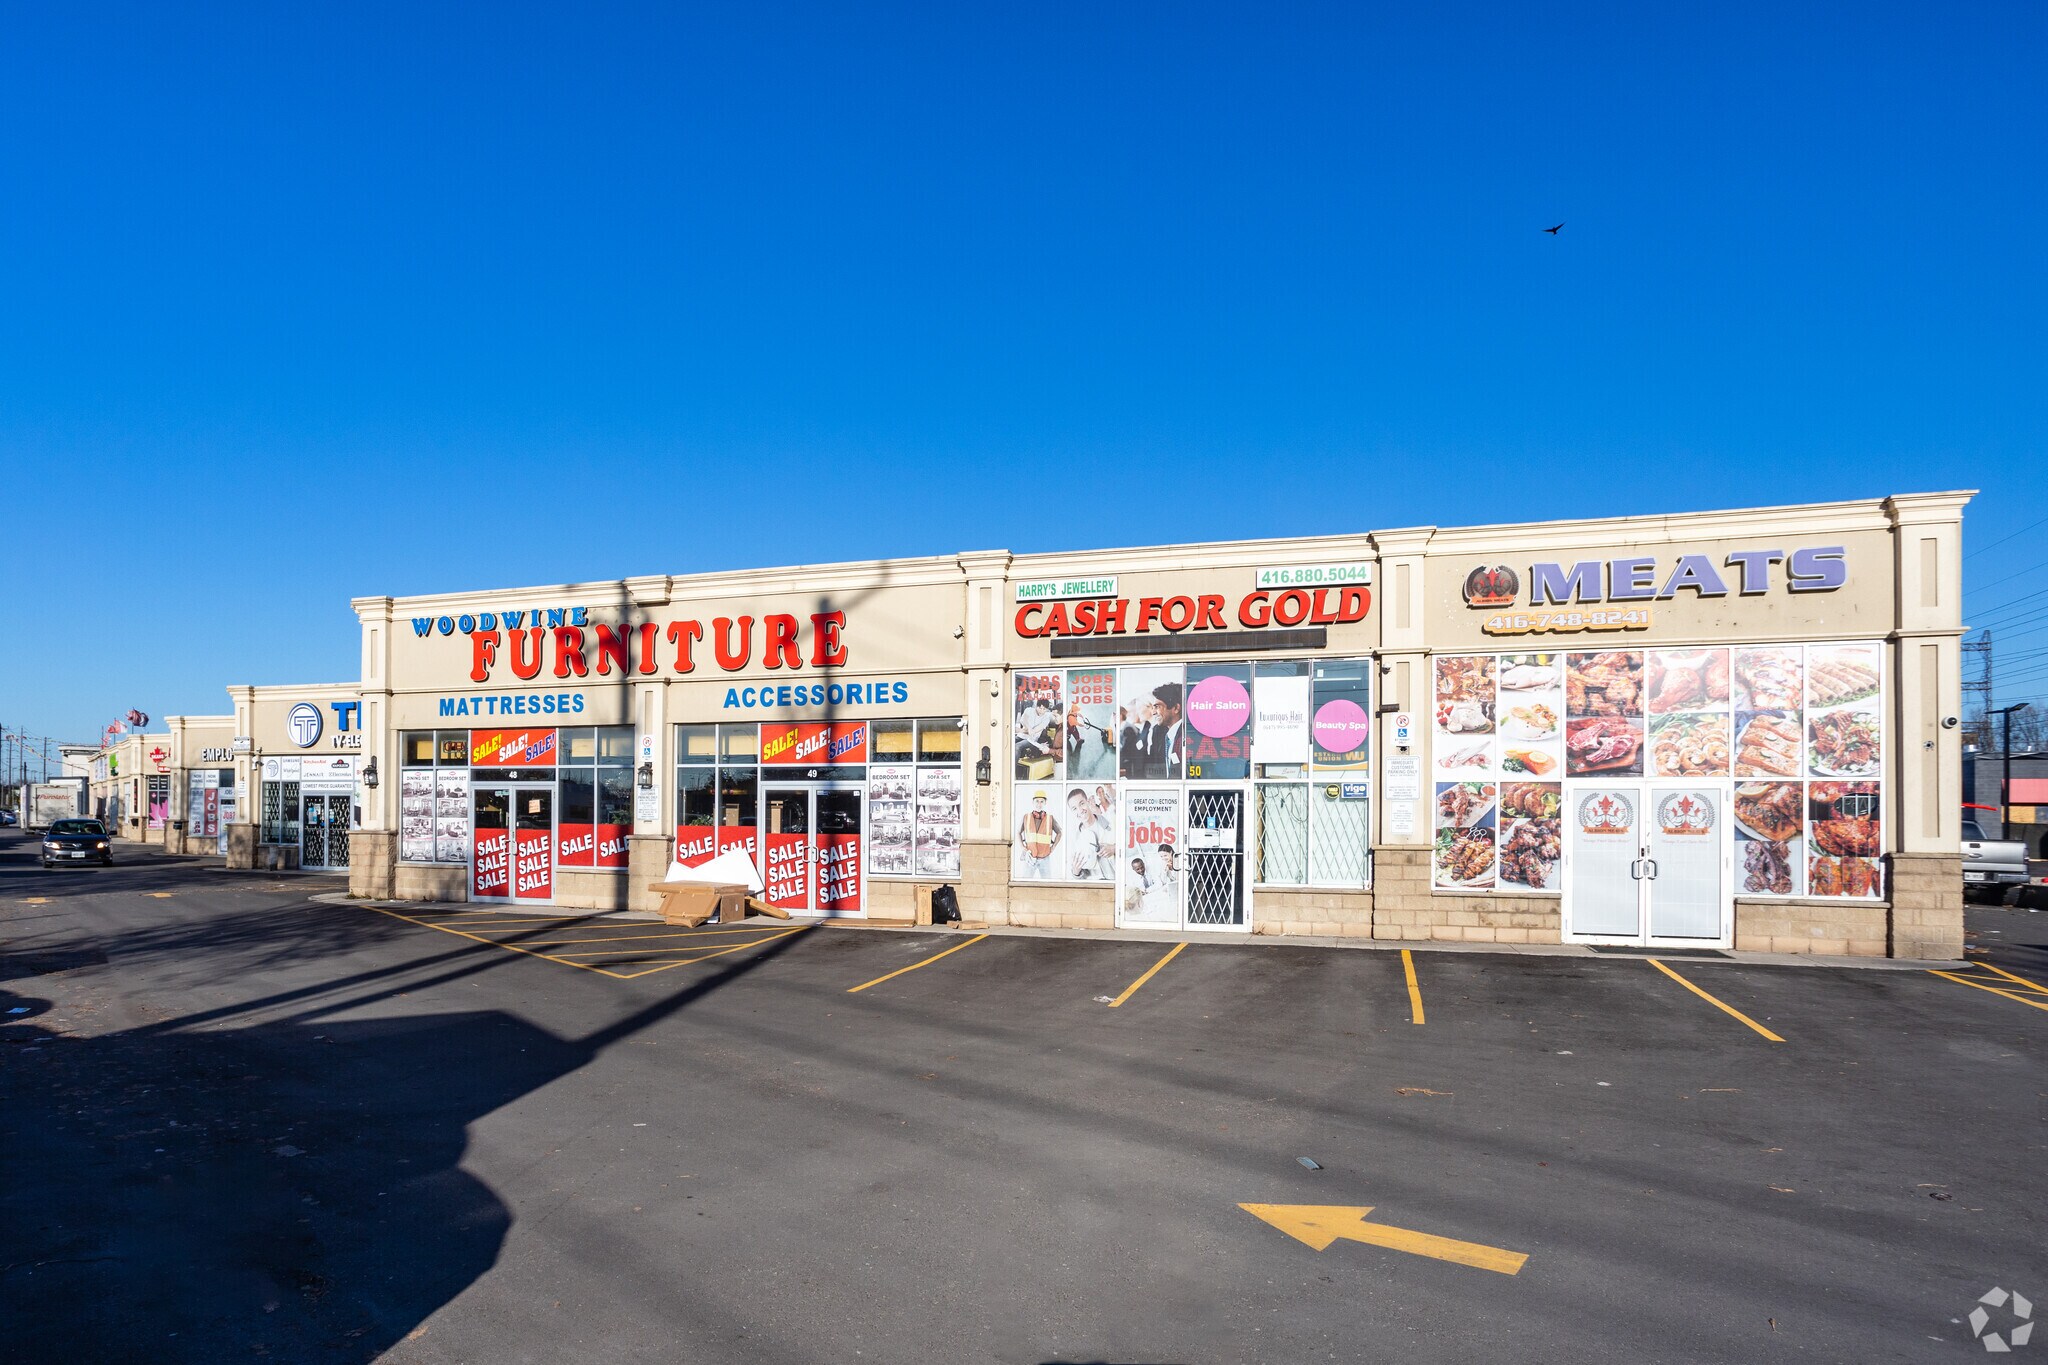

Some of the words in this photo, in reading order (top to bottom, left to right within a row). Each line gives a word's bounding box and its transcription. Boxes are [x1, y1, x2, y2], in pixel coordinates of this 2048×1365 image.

[1261, 566, 1367, 584] 416.880.5044
[1531, 546, 1847, 603] MEATS
[1018, 583, 1057, 598] HARRY'S
[1061, 579, 1115, 596] JEWELLERY
[411, 606, 588, 637] WOODWINE
[1014, 598, 1130, 639] CASH
[1134, 594, 1228, 633] FOR
[1238, 587, 1372, 628] GOLD
[1487, 610, 1650, 630] 416-748-8241
[470, 610, 848, 682] FURNITURE
[1018, 675, 1061, 692] JOBS
[1071, 674, 1113, 685] JOBS
[1071, 685, 1113, 695] JOBS
[439, 693, 585, 717] MATTRESSES
[723, 681, 909, 709] ACCESSORIES
[1071, 695, 1113, 705] JOBS
[1190, 701, 1214, 710] Hair
[1215, 700, 1246, 710] Salon
[1290, 710, 1303, 722] Hair
[1315, 721, 1347, 732] Beauty
[1348, 721, 1366, 731] Spa
[473, 733, 502, 763] SALE!
[499, 732, 529, 763] SALE!
[525, 731, 556, 763] SALE!
[763, 727, 799, 761] SALE!
[795, 727, 831, 760] SALE!
[828, 726, 865, 760] SALE!
[1345, 751, 1365, 761] WU
[807, 769, 818, 778] 49
[1189, 765, 1201, 777] 50
[1344, 784, 1366, 794] vigo
[207, 792, 217, 833] JOBS
[477, 834, 507, 856] SALE
[518, 835, 550, 858] SALE
[561, 833, 594, 856] SALE
[600, 835, 630, 857] SALE
[1128, 822, 1177, 849] jobs
[679, 835, 714, 859] SALE
[768, 839, 804, 864] SALE
[819, 840, 858, 865] SALE
[477, 852, 507, 873] SALE
[518, 853, 550, 874] SALE
[768, 859, 805, 883] SALE
[819, 859, 858, 884] SALE
[477, 869, 507, 890] SALE
[518, 870, 550, 892] SALE
[768, 878, 805, 902] SALE
[819, 879, 858, 904] SALE
